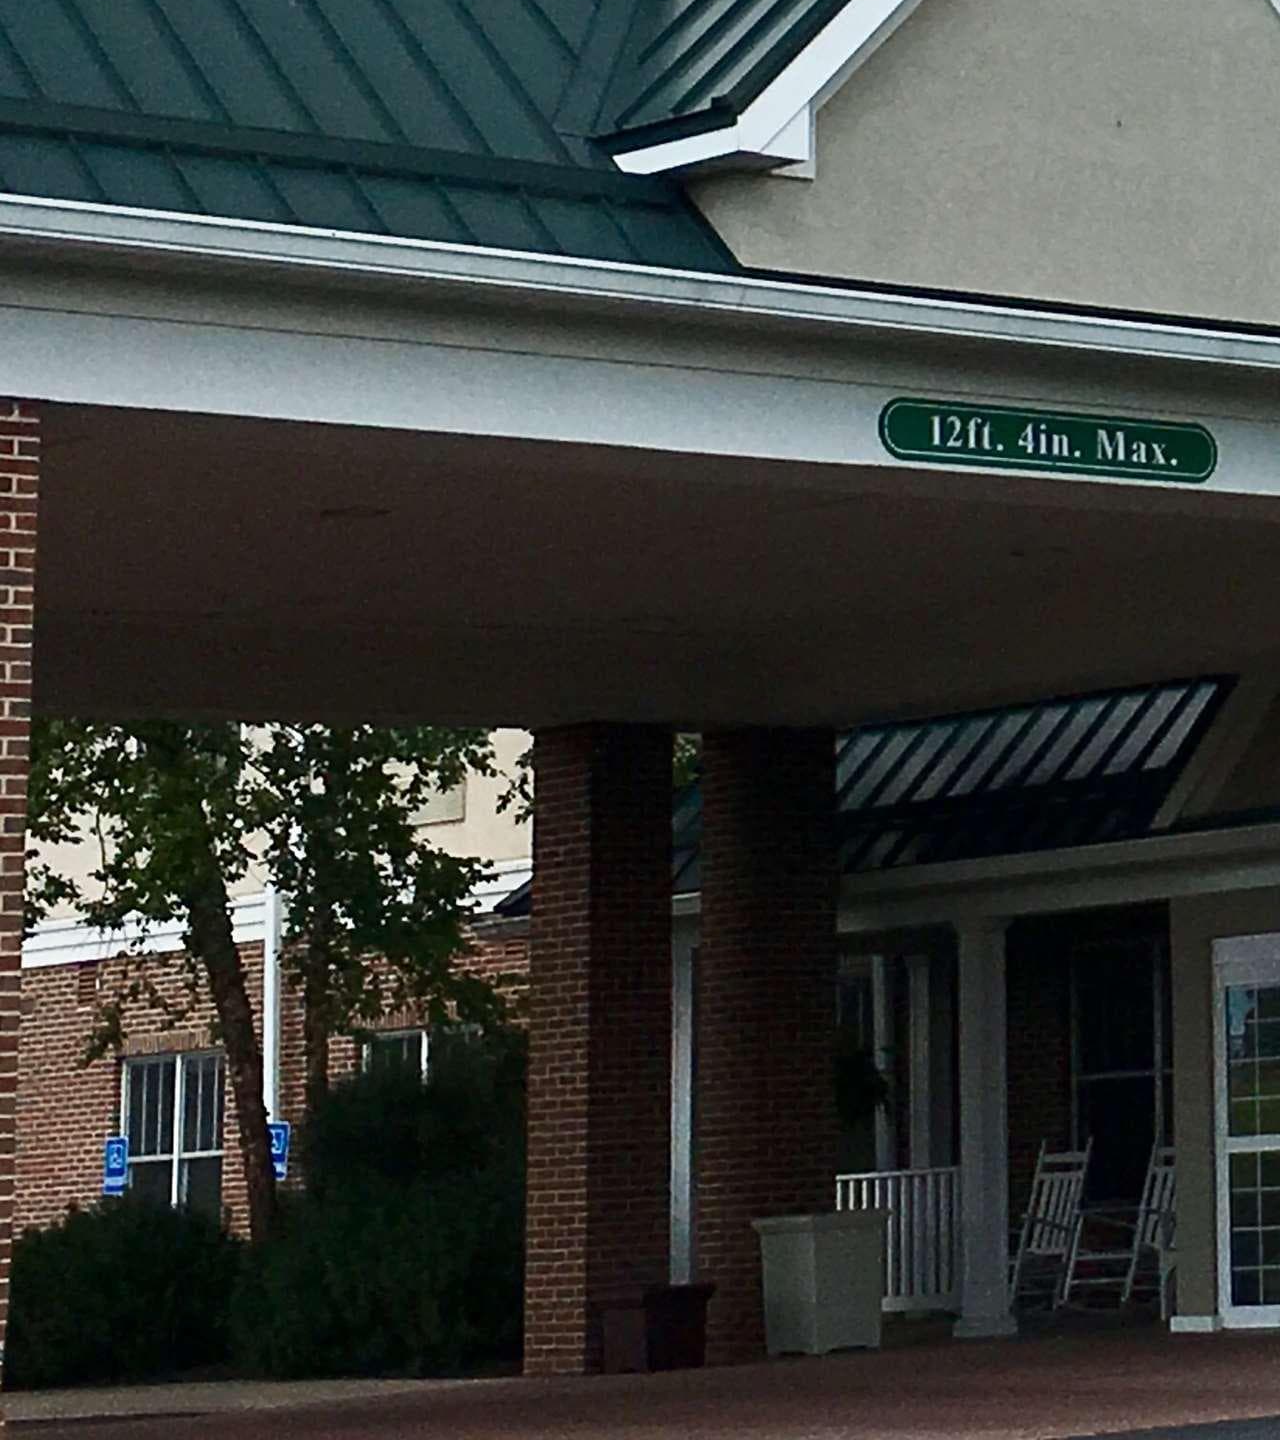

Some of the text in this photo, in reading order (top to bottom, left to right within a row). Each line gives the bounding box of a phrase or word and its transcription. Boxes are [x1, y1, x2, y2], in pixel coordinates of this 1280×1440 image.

[929, 415, 1178, 466] 12ft. 4in. Max.
